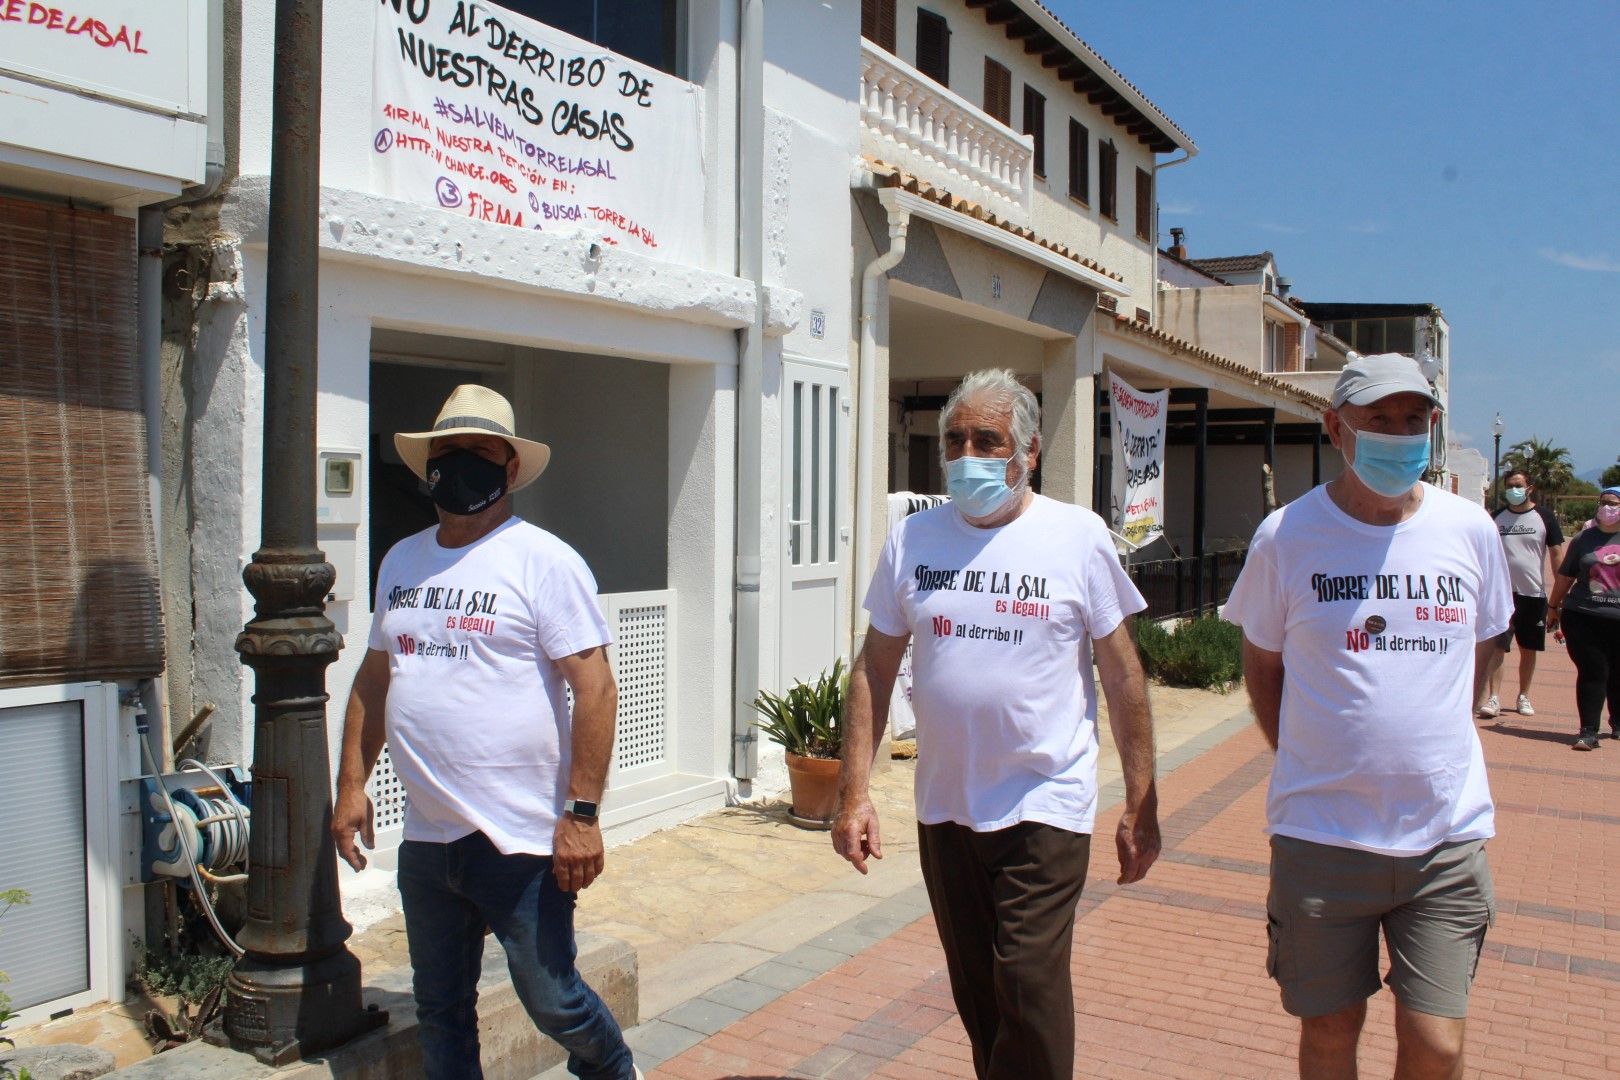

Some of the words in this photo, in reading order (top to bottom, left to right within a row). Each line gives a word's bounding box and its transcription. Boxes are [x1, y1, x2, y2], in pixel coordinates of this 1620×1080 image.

[448, 0, 480, 37] AL
[484, 17, 605, 87] DERRIBO
[618, 70, 654, 107] DE
[398, 27, 543, 126] NUESTRAS
[551, 100, 635, 152] CASAS
[436, 127, 493, 154] NUESTRA
[963, 570, 985, 593] DE
[990, 571, 1010, 594] LA
[1375, 575, 1399, 600] DE
[1406, 575, 1429, 600] LA
[423, 587, 443, 610] DE
[444, 588, 464, 611] LA
[995, 599, 1007, 613] es
[446, 616, 456, 629] es
[1416, 606, 1429, 621] es
[956, 623, 966, 639] al
[968, 624, 1010, 642] derribo
[417, 642, 425, 656] al
[426, 641, 458, 658] derribo
[1375, 635, 1386, 652] al
[1389, 635, 1436, 652] derribo
